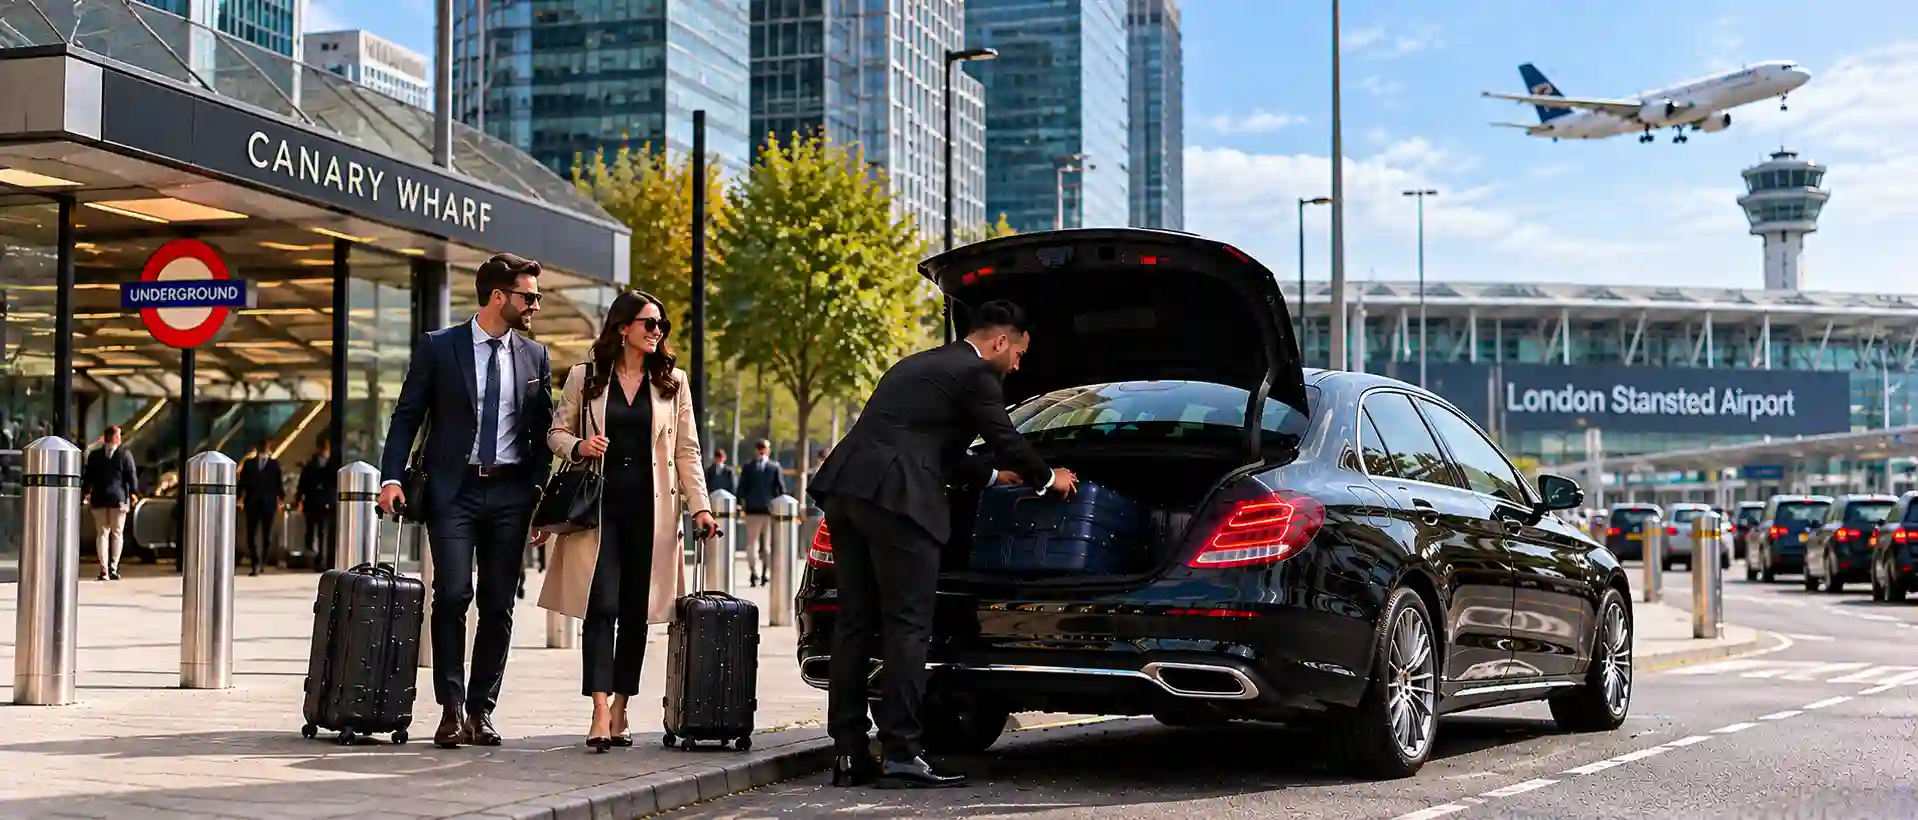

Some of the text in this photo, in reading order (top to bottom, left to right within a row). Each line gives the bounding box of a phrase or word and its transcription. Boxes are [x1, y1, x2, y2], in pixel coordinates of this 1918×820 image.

[247, 131, 493, 232] CANARY WHARF
[130, 286, 238, 301] UNDERGROUND
[1507, 382, 1796, 422] London Stansted Airport
